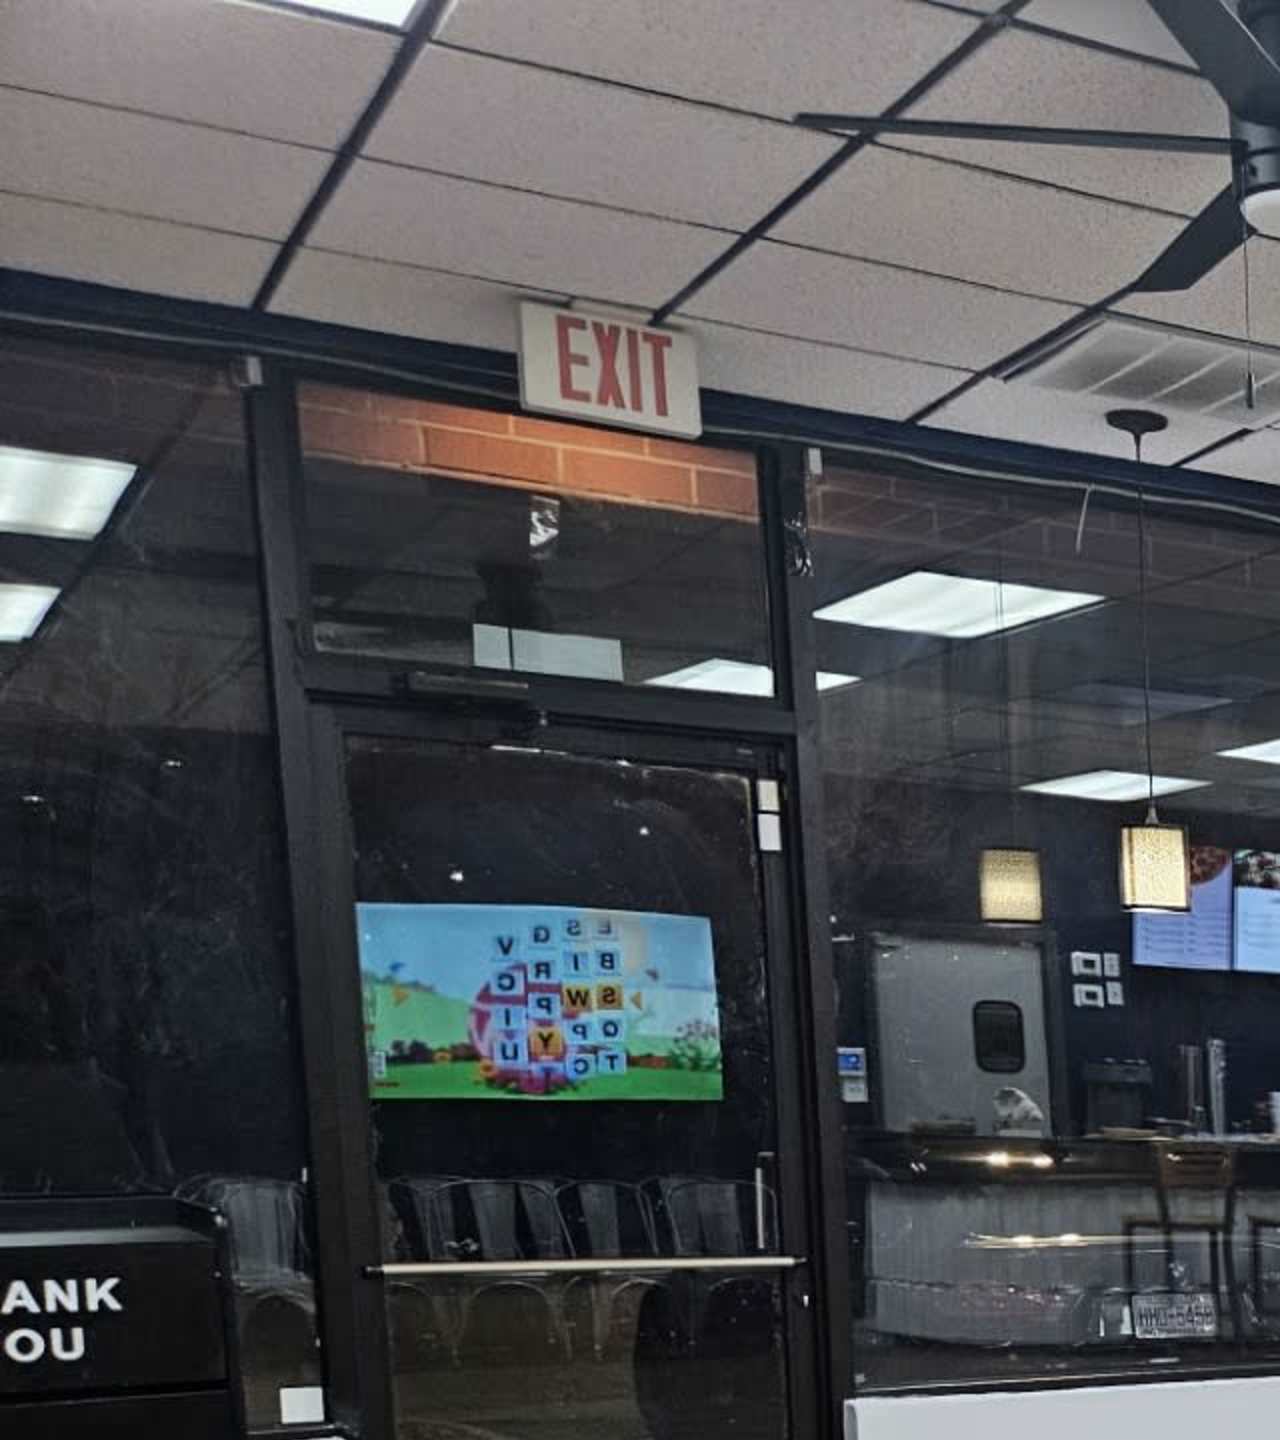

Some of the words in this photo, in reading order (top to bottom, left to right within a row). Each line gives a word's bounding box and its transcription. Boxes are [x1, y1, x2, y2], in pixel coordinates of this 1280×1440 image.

[556, 315, 672, 416] EXIT
[0, 1277, 123, 1314] ANK
[4, 1327, 85, 1363] OU
